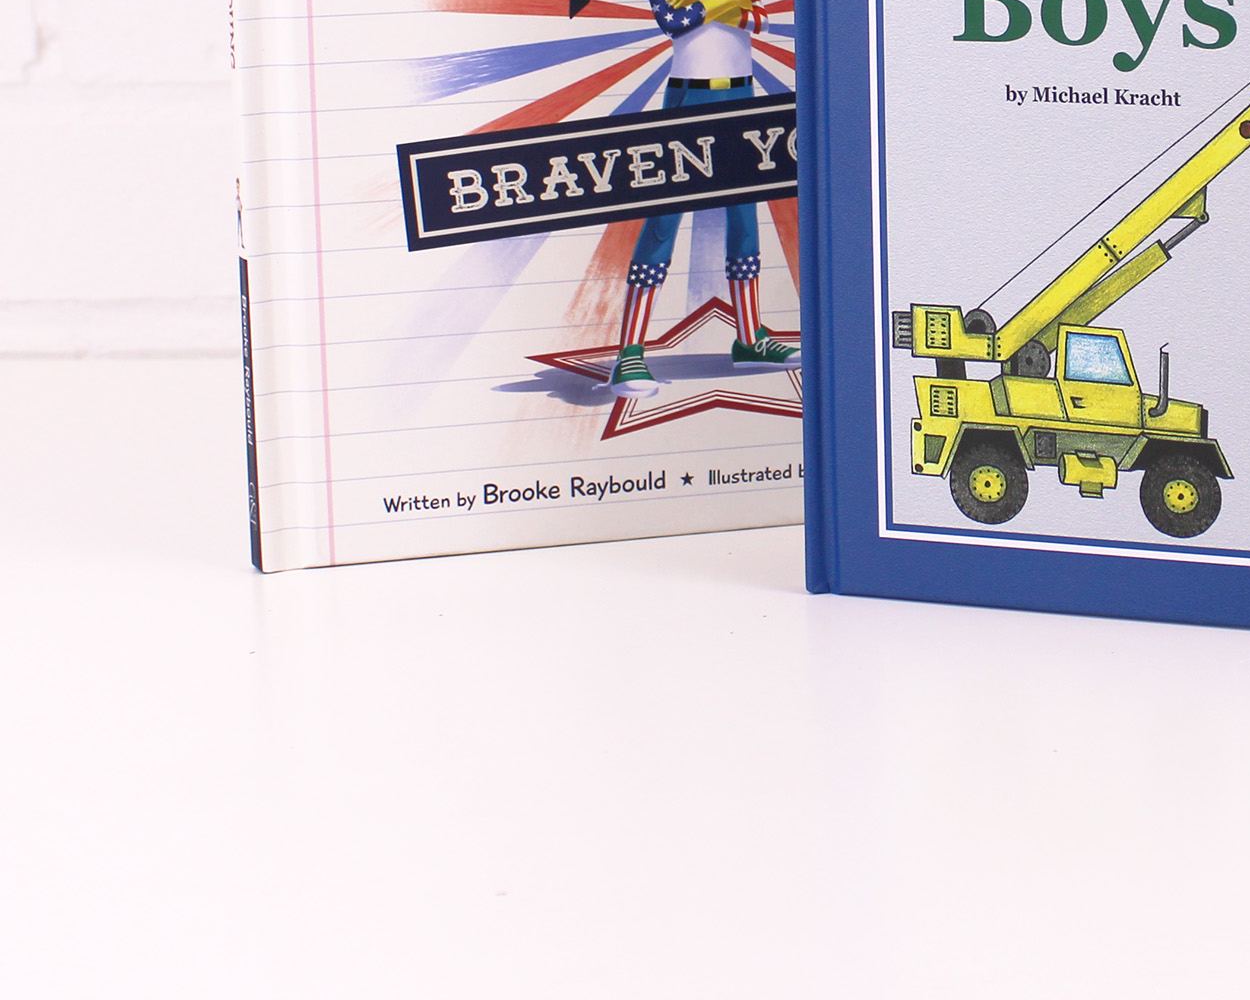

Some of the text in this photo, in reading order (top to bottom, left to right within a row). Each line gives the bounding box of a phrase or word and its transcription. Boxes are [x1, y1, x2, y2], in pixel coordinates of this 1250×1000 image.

[1005, 84, 1181, 107] by Michael Kracht
[447, 136, 715, 213] BRAVEN
[383, 494, 450, 513] Written
[457, 492, 477, 511] by
[483, 480, 561, 505] Brooke
[570, 469, 666, 501] Raybould
[708, 463, 792, 486] Illustrated
